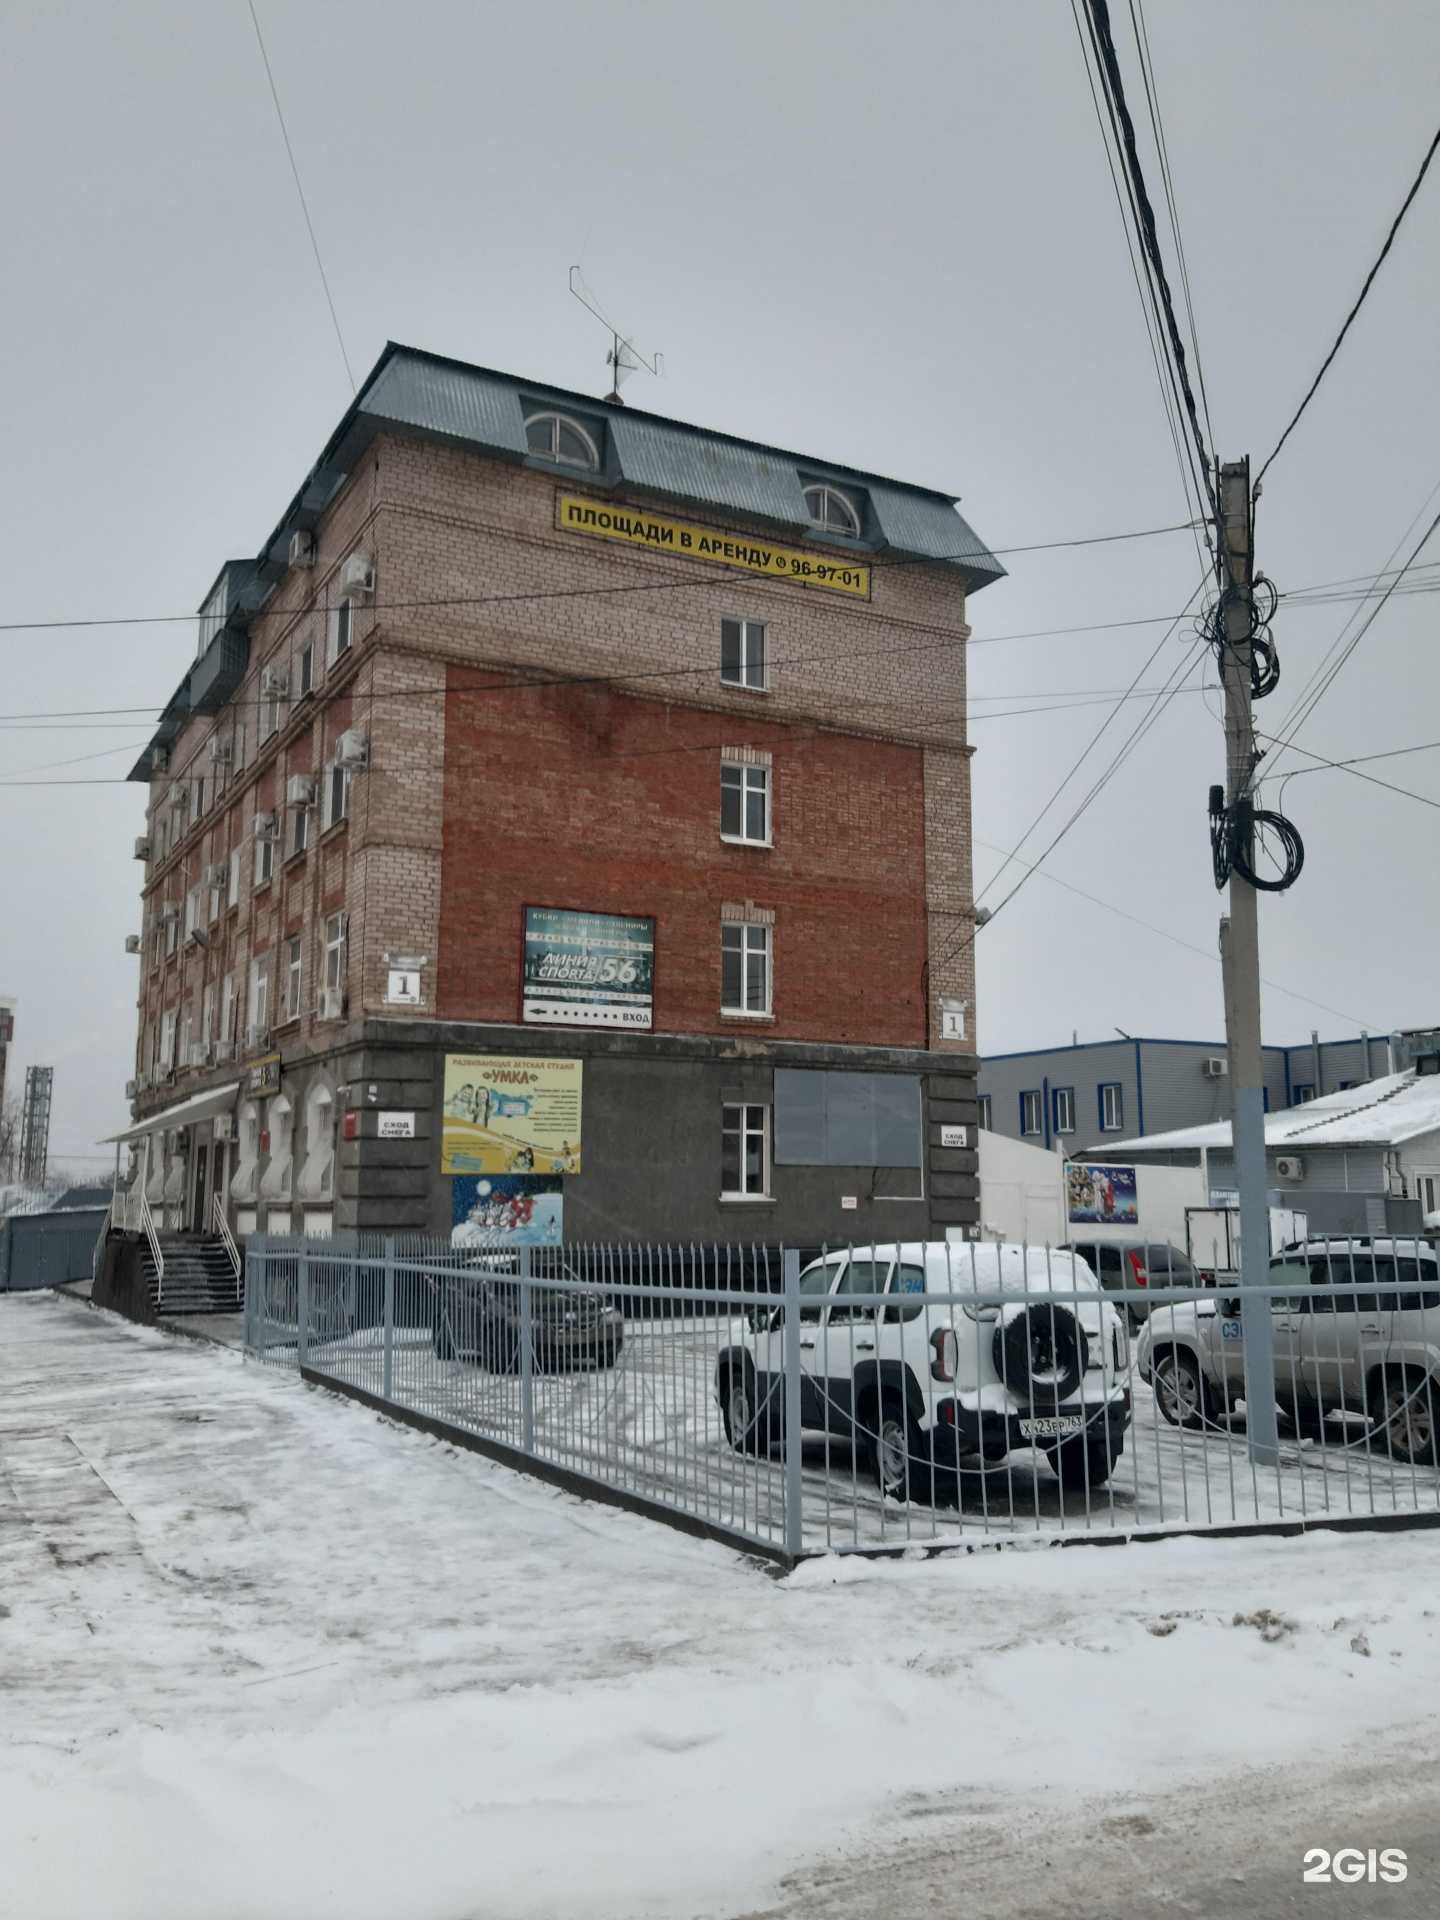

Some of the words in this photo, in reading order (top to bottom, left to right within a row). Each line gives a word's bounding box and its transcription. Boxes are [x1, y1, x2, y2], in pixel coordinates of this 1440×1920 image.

[569, 504, 674, 543] ПЛОЩАДИ
[681, 532, 692, 548] В
[698, 537, 772, 567] АРЕНДУ
[791, 559, 861, 588] 96-97-01
[543, 953, 598, 969] ЛИНИЯ
[538, 966, 595, 981] СПОРТА
[600, 958, 637, 984] 56
[399, 975, 410, 995] 1
[622, 1012, 650, 1024] ВХОД
[949, 1016, 958, 1032] 1
[491, 1069, 530, 1084] УМКА
[383, 1121, 409, 1129] СХОД
[1222, 1322, 1243, 1338] СЭ
